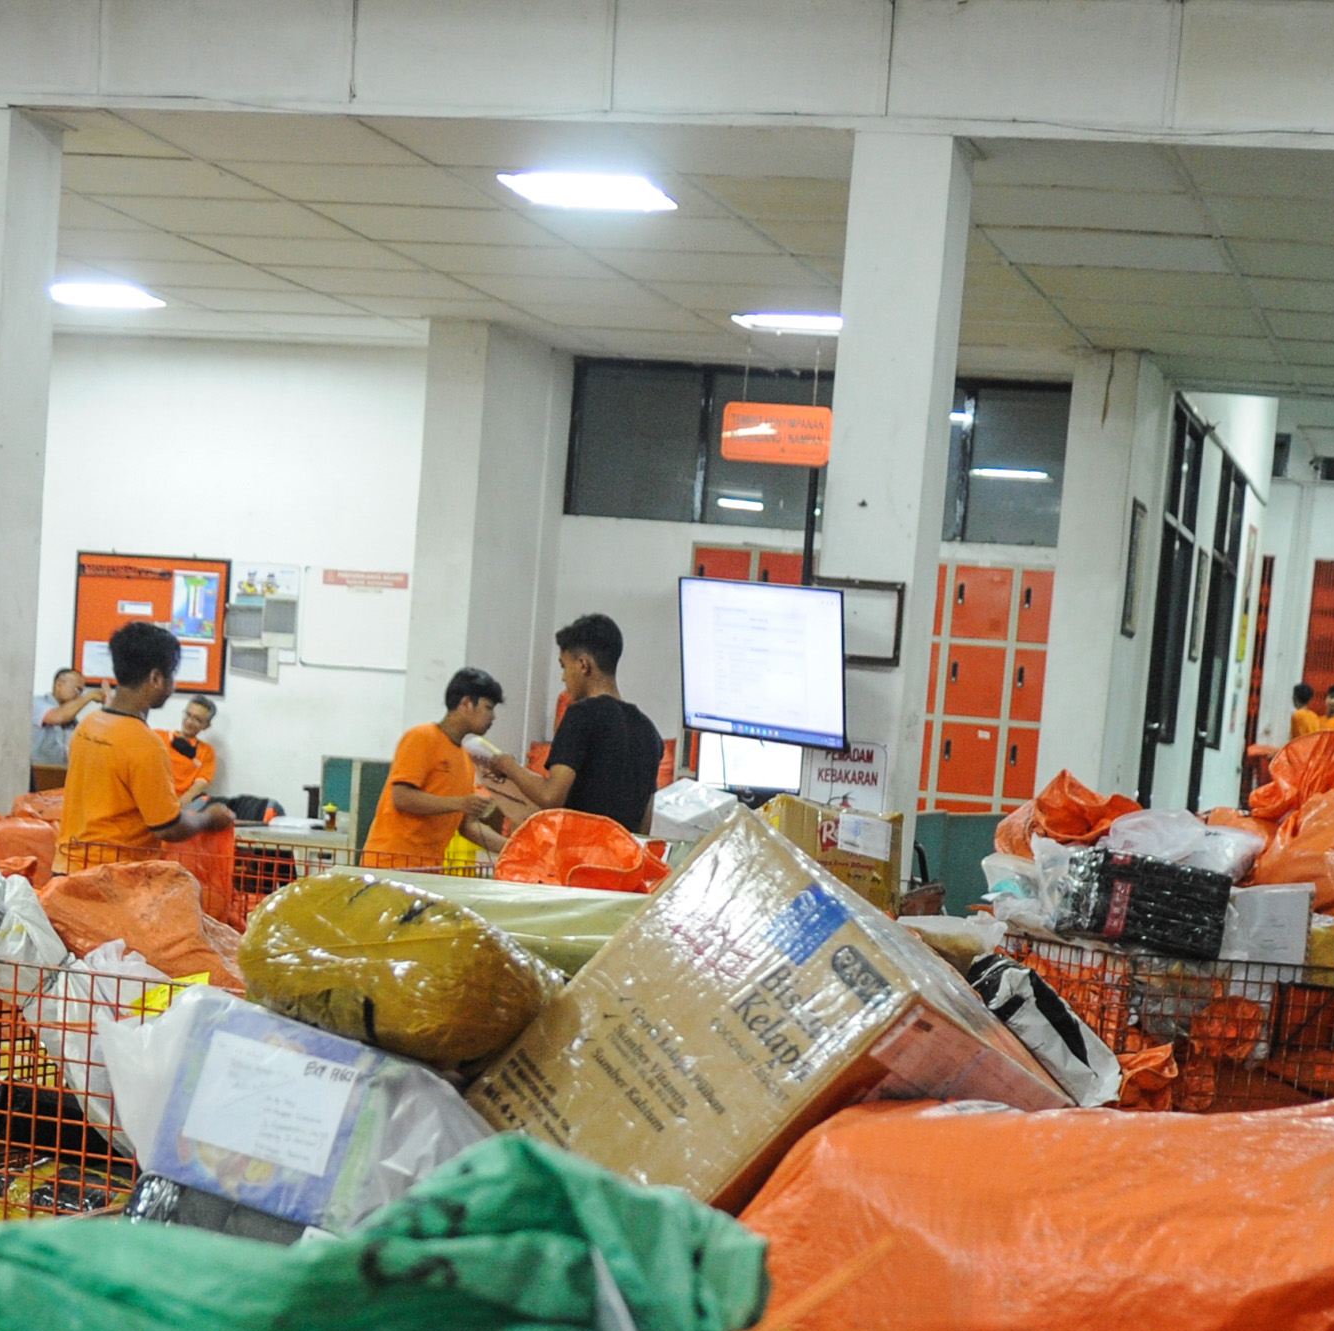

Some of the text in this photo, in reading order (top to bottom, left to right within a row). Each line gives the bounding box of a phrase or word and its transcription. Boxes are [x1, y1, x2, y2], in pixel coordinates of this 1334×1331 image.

[817, 767, 879, 787] KEBAKARAN
[616, 1023, 650, 1068] Sumber
[648, 1063, 689, 1110] Vitamin
[731, 989, 818, 1084] Kelapa
[593, 1046, 630, 1092] Sumber
[625, 1086, 666, 1134] Kalsium
